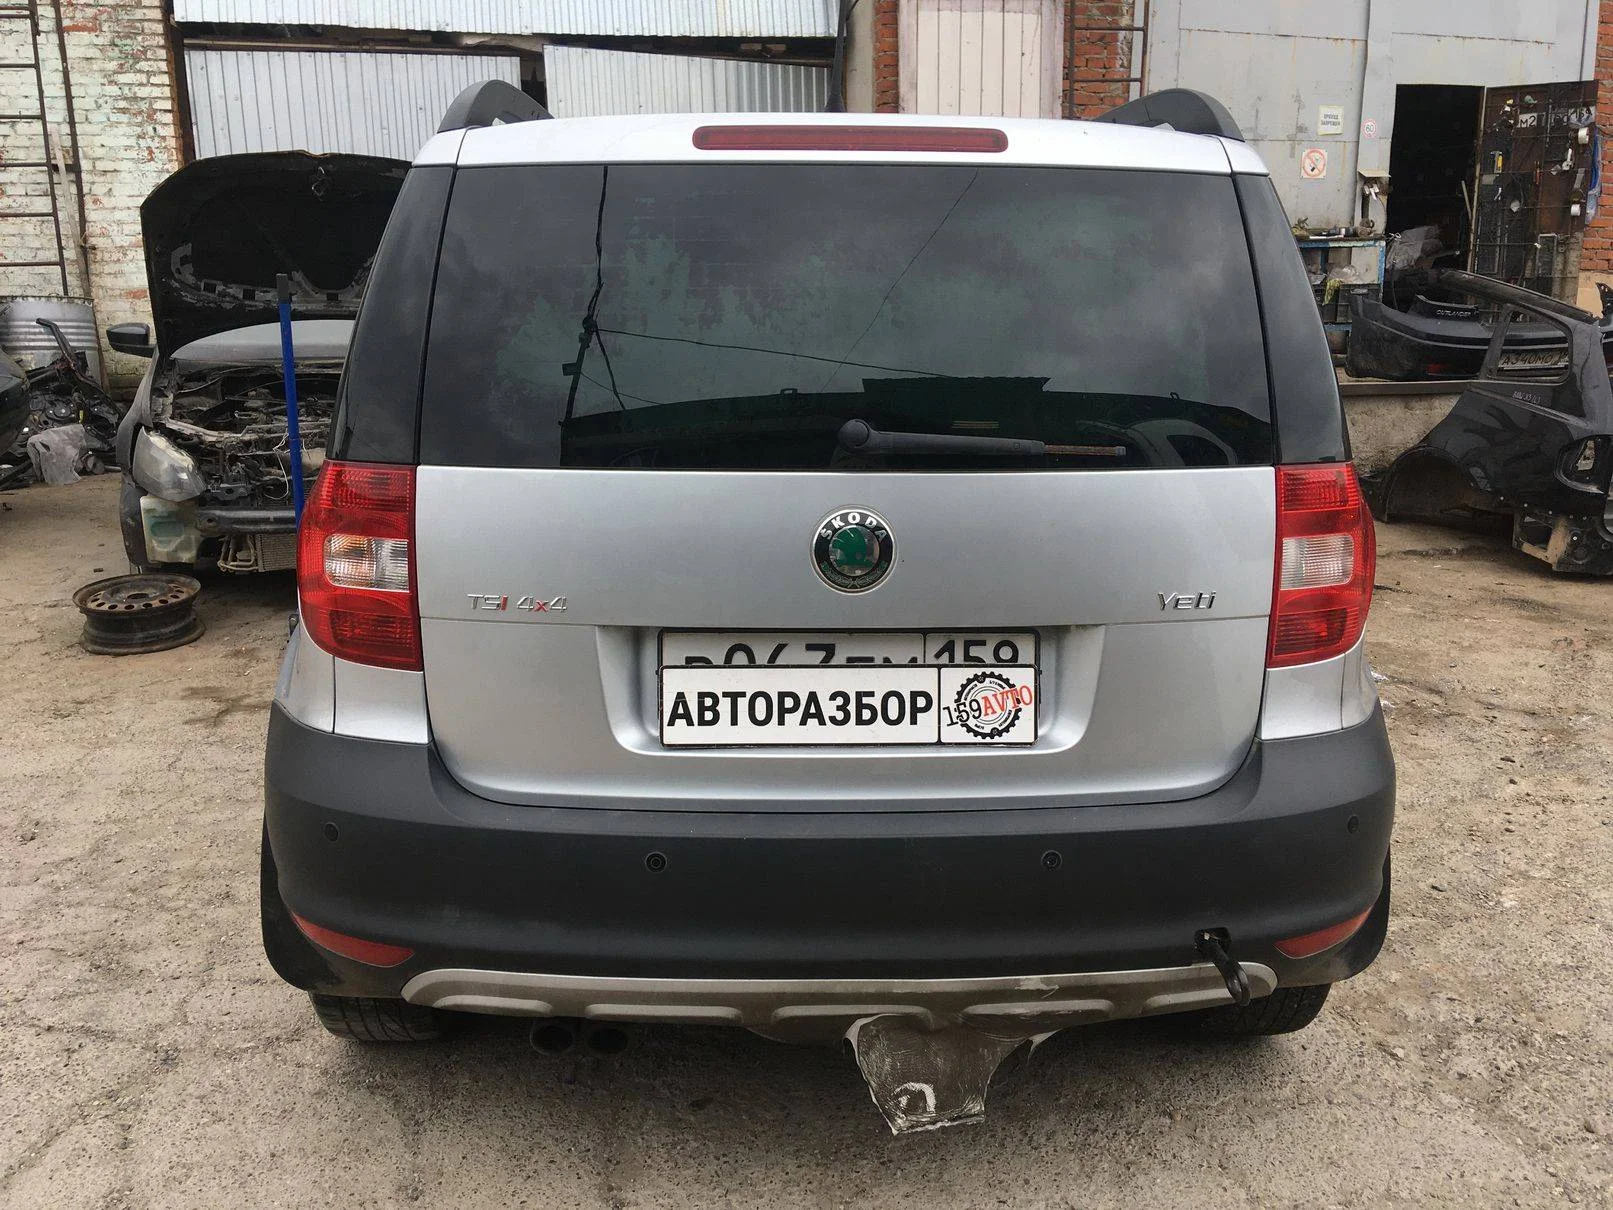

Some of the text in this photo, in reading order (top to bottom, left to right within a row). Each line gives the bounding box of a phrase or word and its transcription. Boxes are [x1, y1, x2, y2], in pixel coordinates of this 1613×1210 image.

[517, 596, 567, 612] 4x4
[1158, 591, 1216, 611] Yeti
[667, 691, 933, 727] АВТОРАЗБОР
